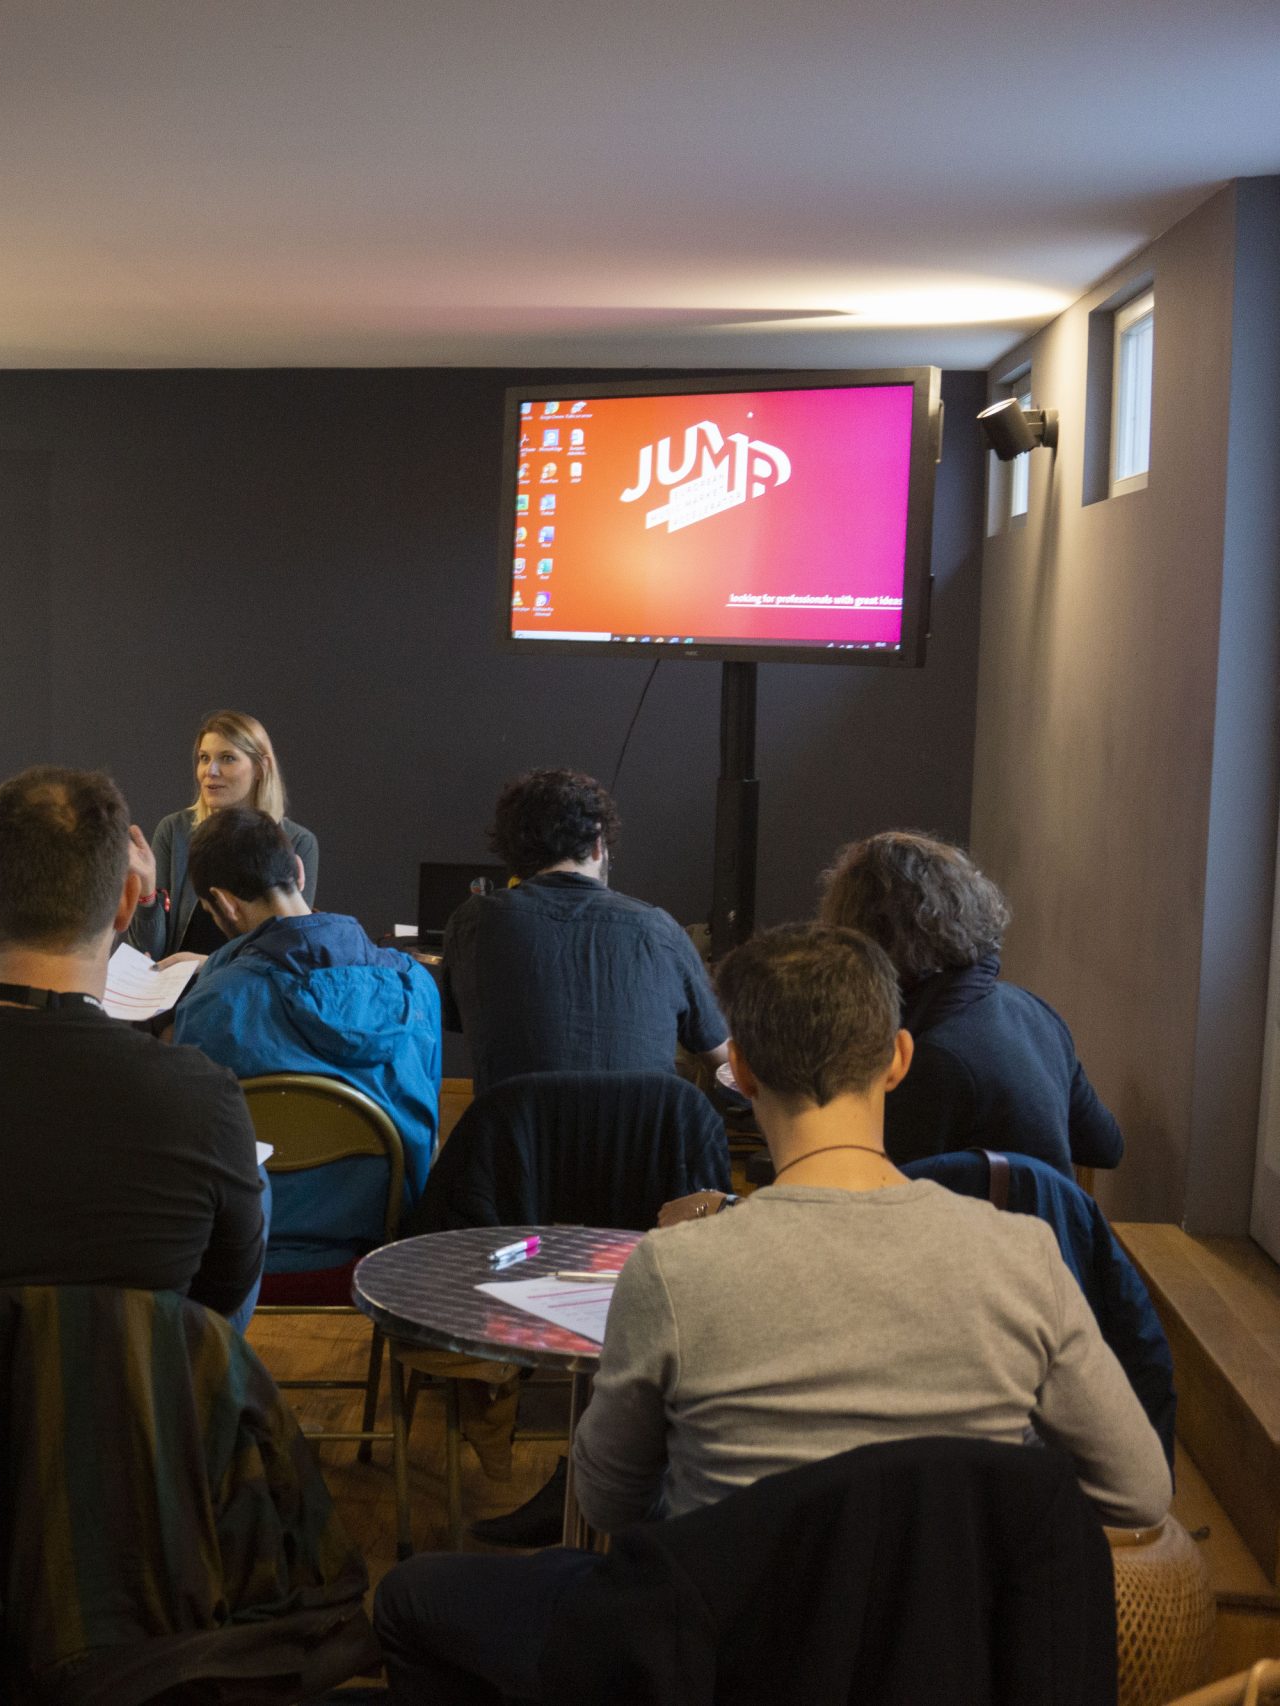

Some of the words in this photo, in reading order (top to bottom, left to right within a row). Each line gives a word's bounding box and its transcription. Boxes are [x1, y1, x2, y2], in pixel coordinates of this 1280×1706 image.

[619, 420, 791, 503] JUMP
[776, 594, 833, 605] professionals
[834, 595, 854, 605] with
